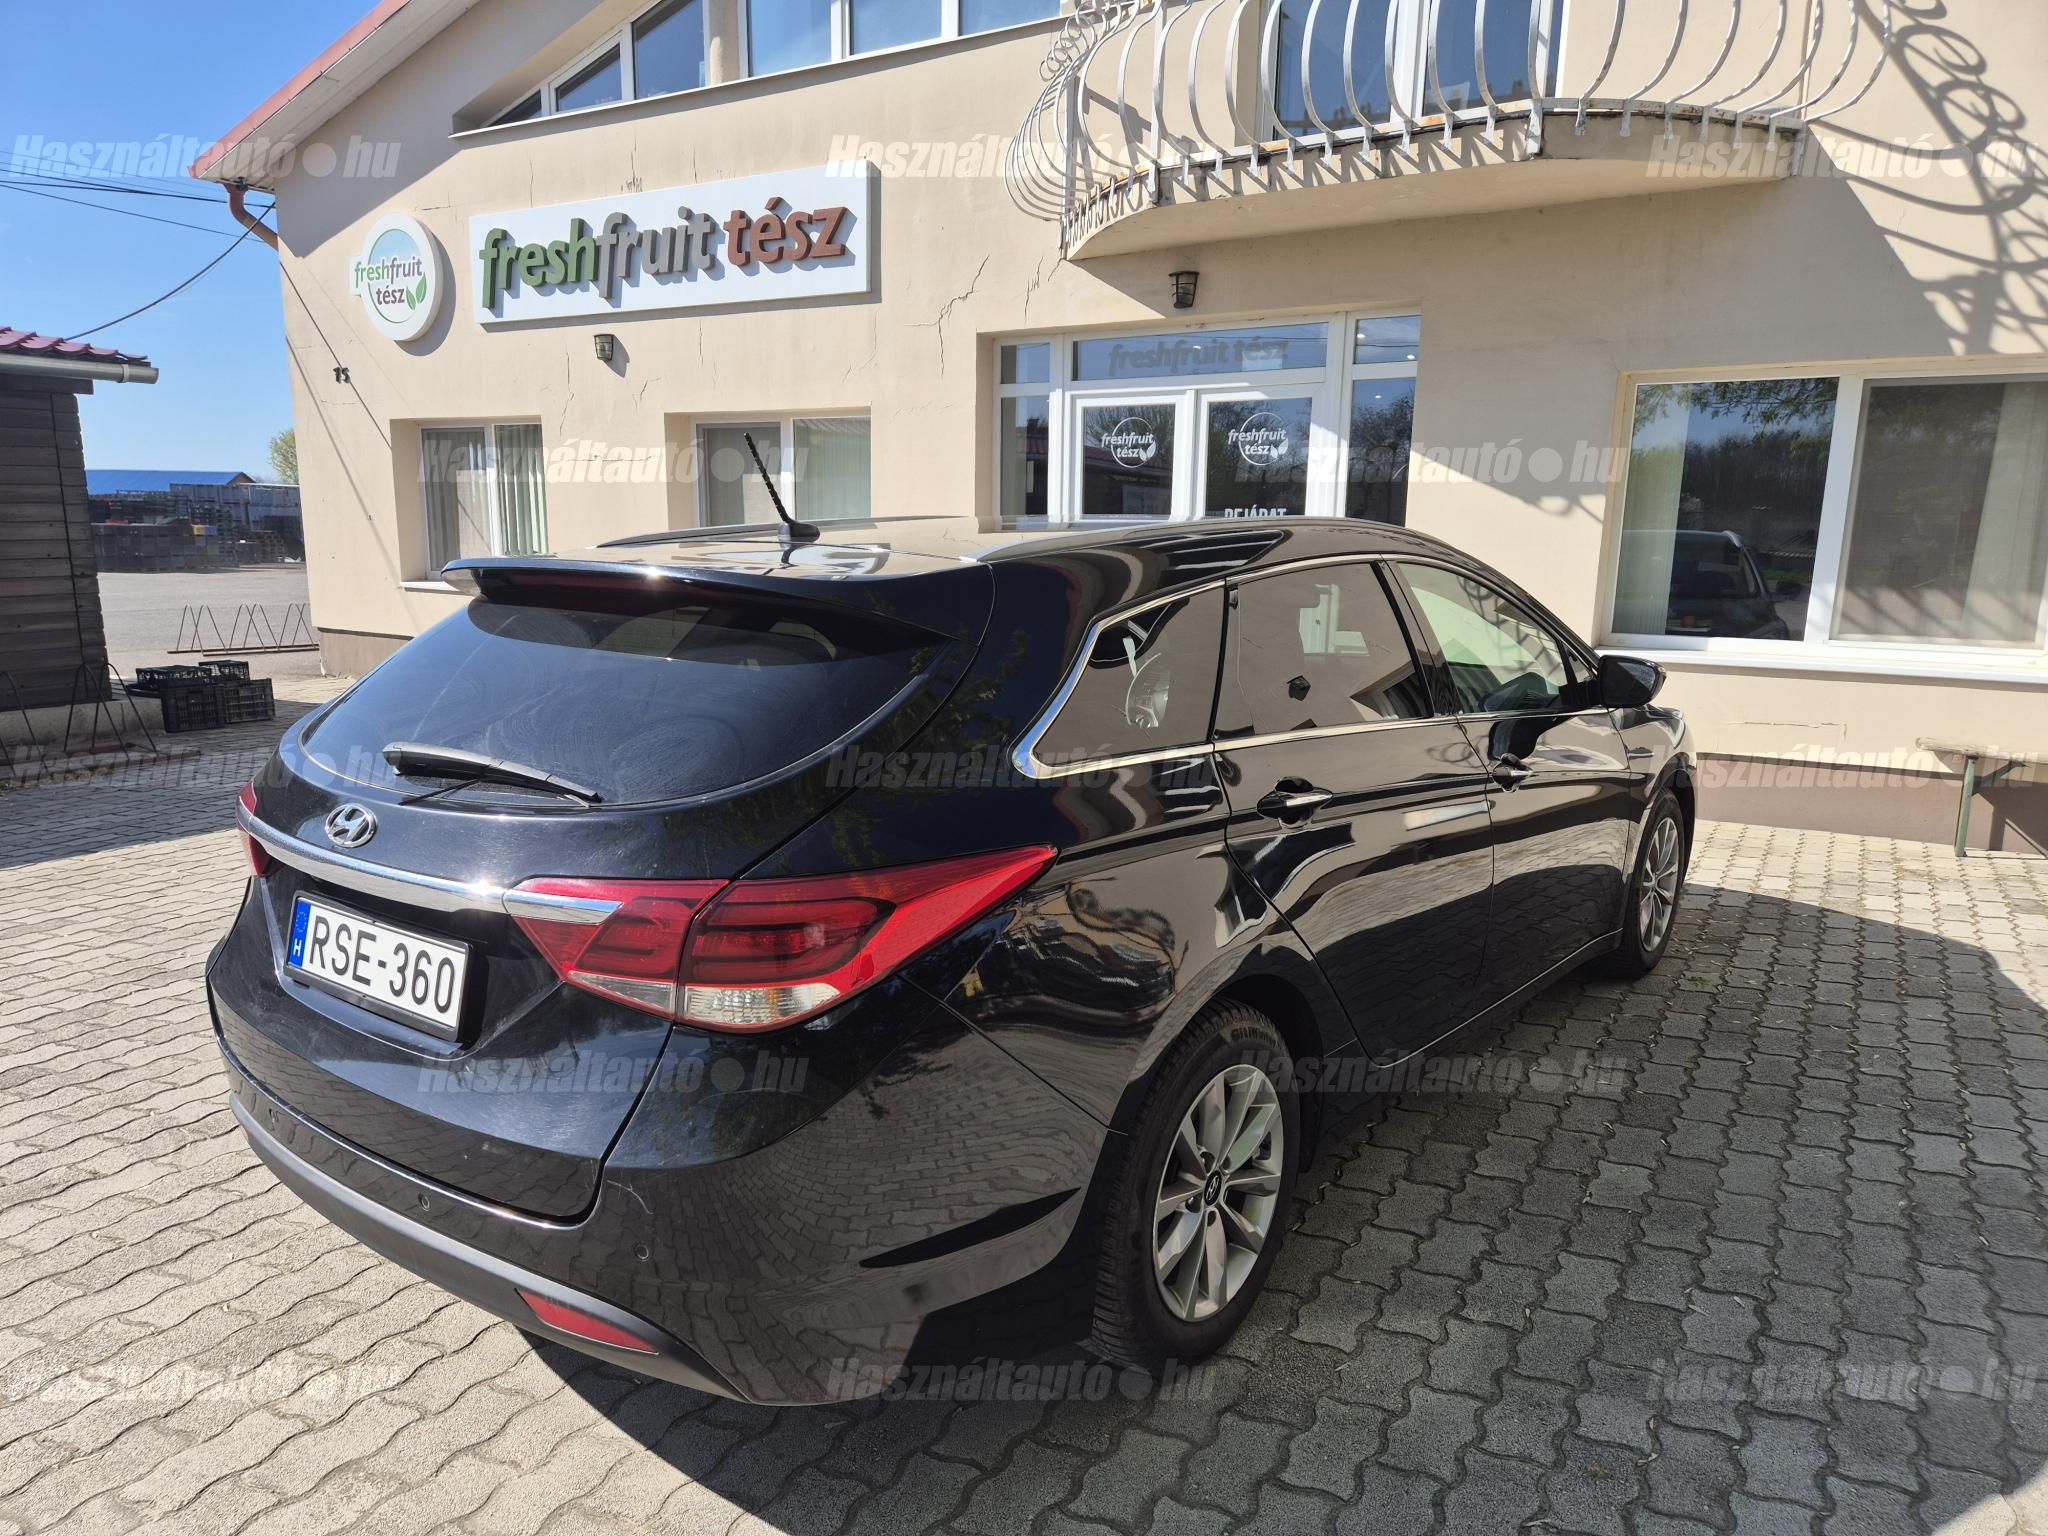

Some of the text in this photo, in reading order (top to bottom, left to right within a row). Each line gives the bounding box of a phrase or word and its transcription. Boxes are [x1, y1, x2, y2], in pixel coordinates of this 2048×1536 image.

[478, 196, 850, 309] freshfruit tész
[354, 256, 423, 289] freshfruit
[376, 284, 405, 305] tész
[1108, 339, 1229, 377] freshfruit
[333, 366, 350, 384] 15
[1101, 431, 1155, 448] freshfruit
[1228, 428, 1287, 445] freshfruit
[1116, 444, 1140, 458] tész
[1244, 442, 1269, 456] tész
[308, 914, 456, 1014] RSE-360
